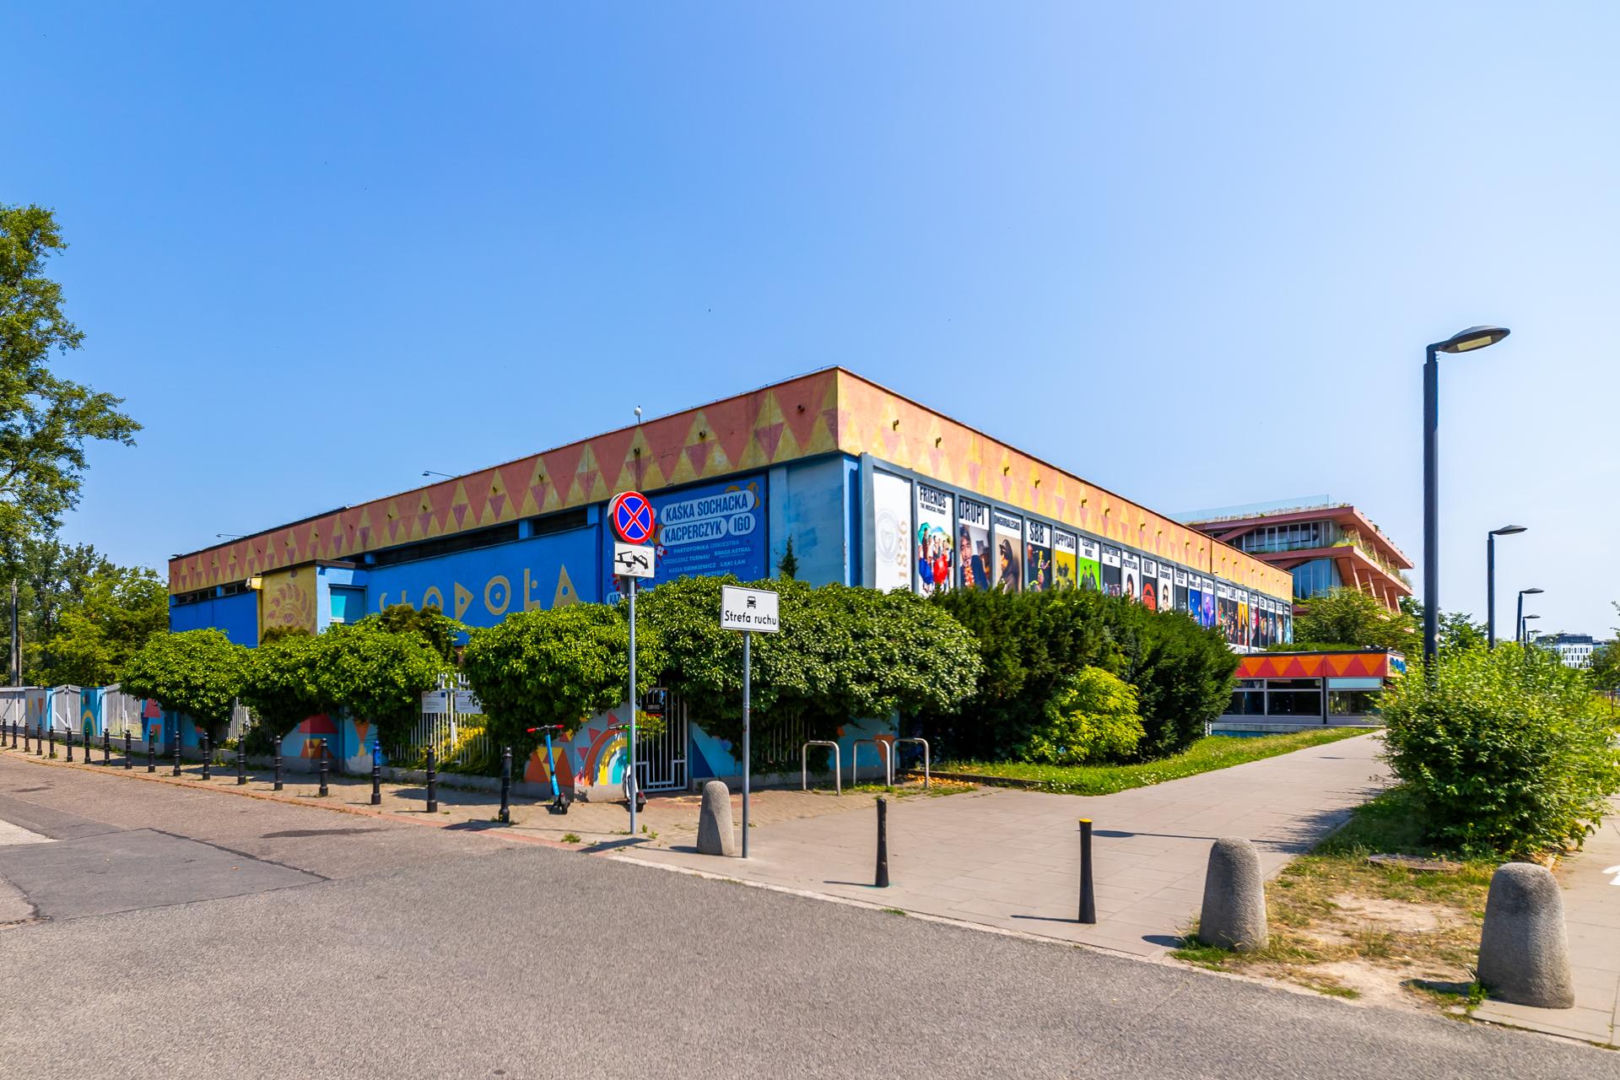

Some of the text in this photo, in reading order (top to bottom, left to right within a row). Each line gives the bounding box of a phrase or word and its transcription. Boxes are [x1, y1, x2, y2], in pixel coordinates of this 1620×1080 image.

[697, 493, 748, 516] SOCHACKA
[665, 516, 751, 543] KACPERCZYK IGO
[725, 610, 777, 625] Strefa ruchu
